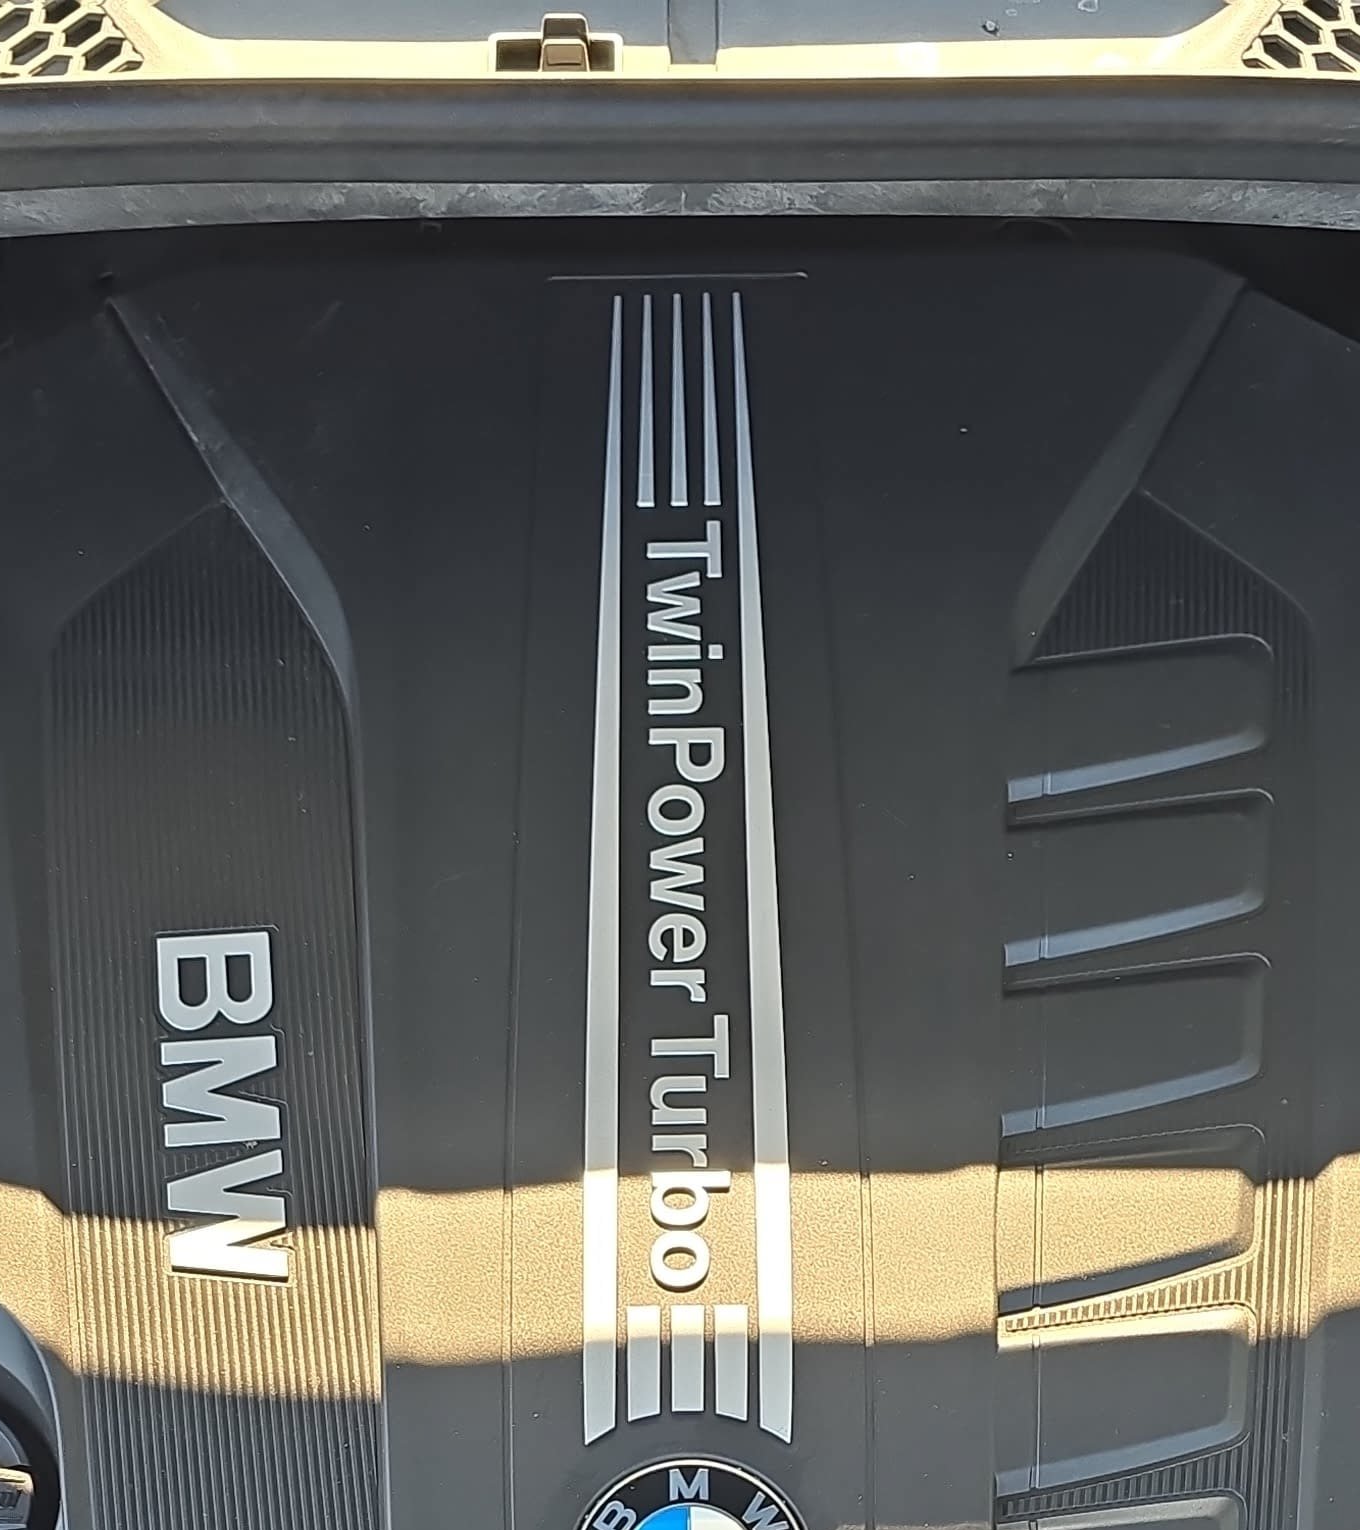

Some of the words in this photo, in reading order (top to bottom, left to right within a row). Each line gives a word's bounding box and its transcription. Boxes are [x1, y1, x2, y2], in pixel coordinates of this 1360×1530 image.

[646, 520, 725, 1002] TwinPower
[156, 931, 290, 1283] BMW
[649, 1014, 731, 1292] Turbo
